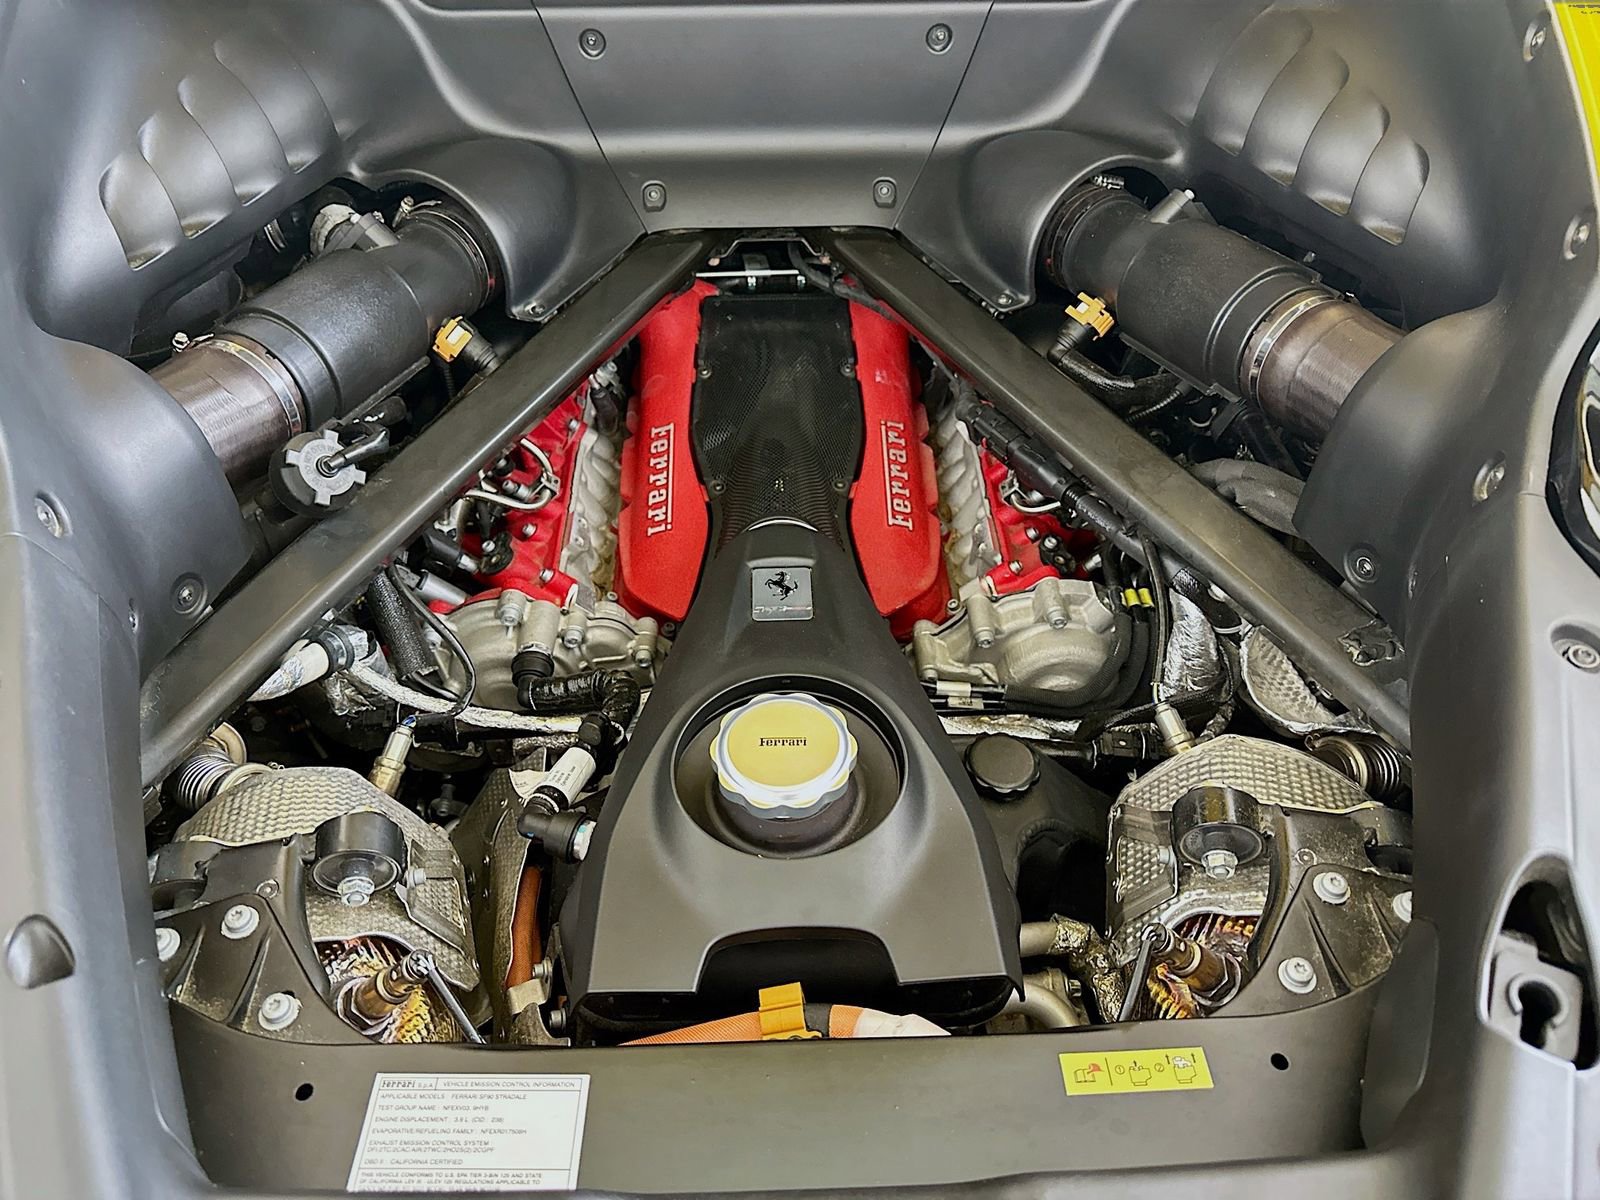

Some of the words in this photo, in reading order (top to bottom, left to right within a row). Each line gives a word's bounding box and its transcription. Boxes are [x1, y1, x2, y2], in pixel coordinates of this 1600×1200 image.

[647, 423, 674, 536] Ferrari
[881, 420, 913, 530] Ferrari
[760, 736, 806, 746] Ferrari
[382, 1080, 416, 1088] Ferrari
